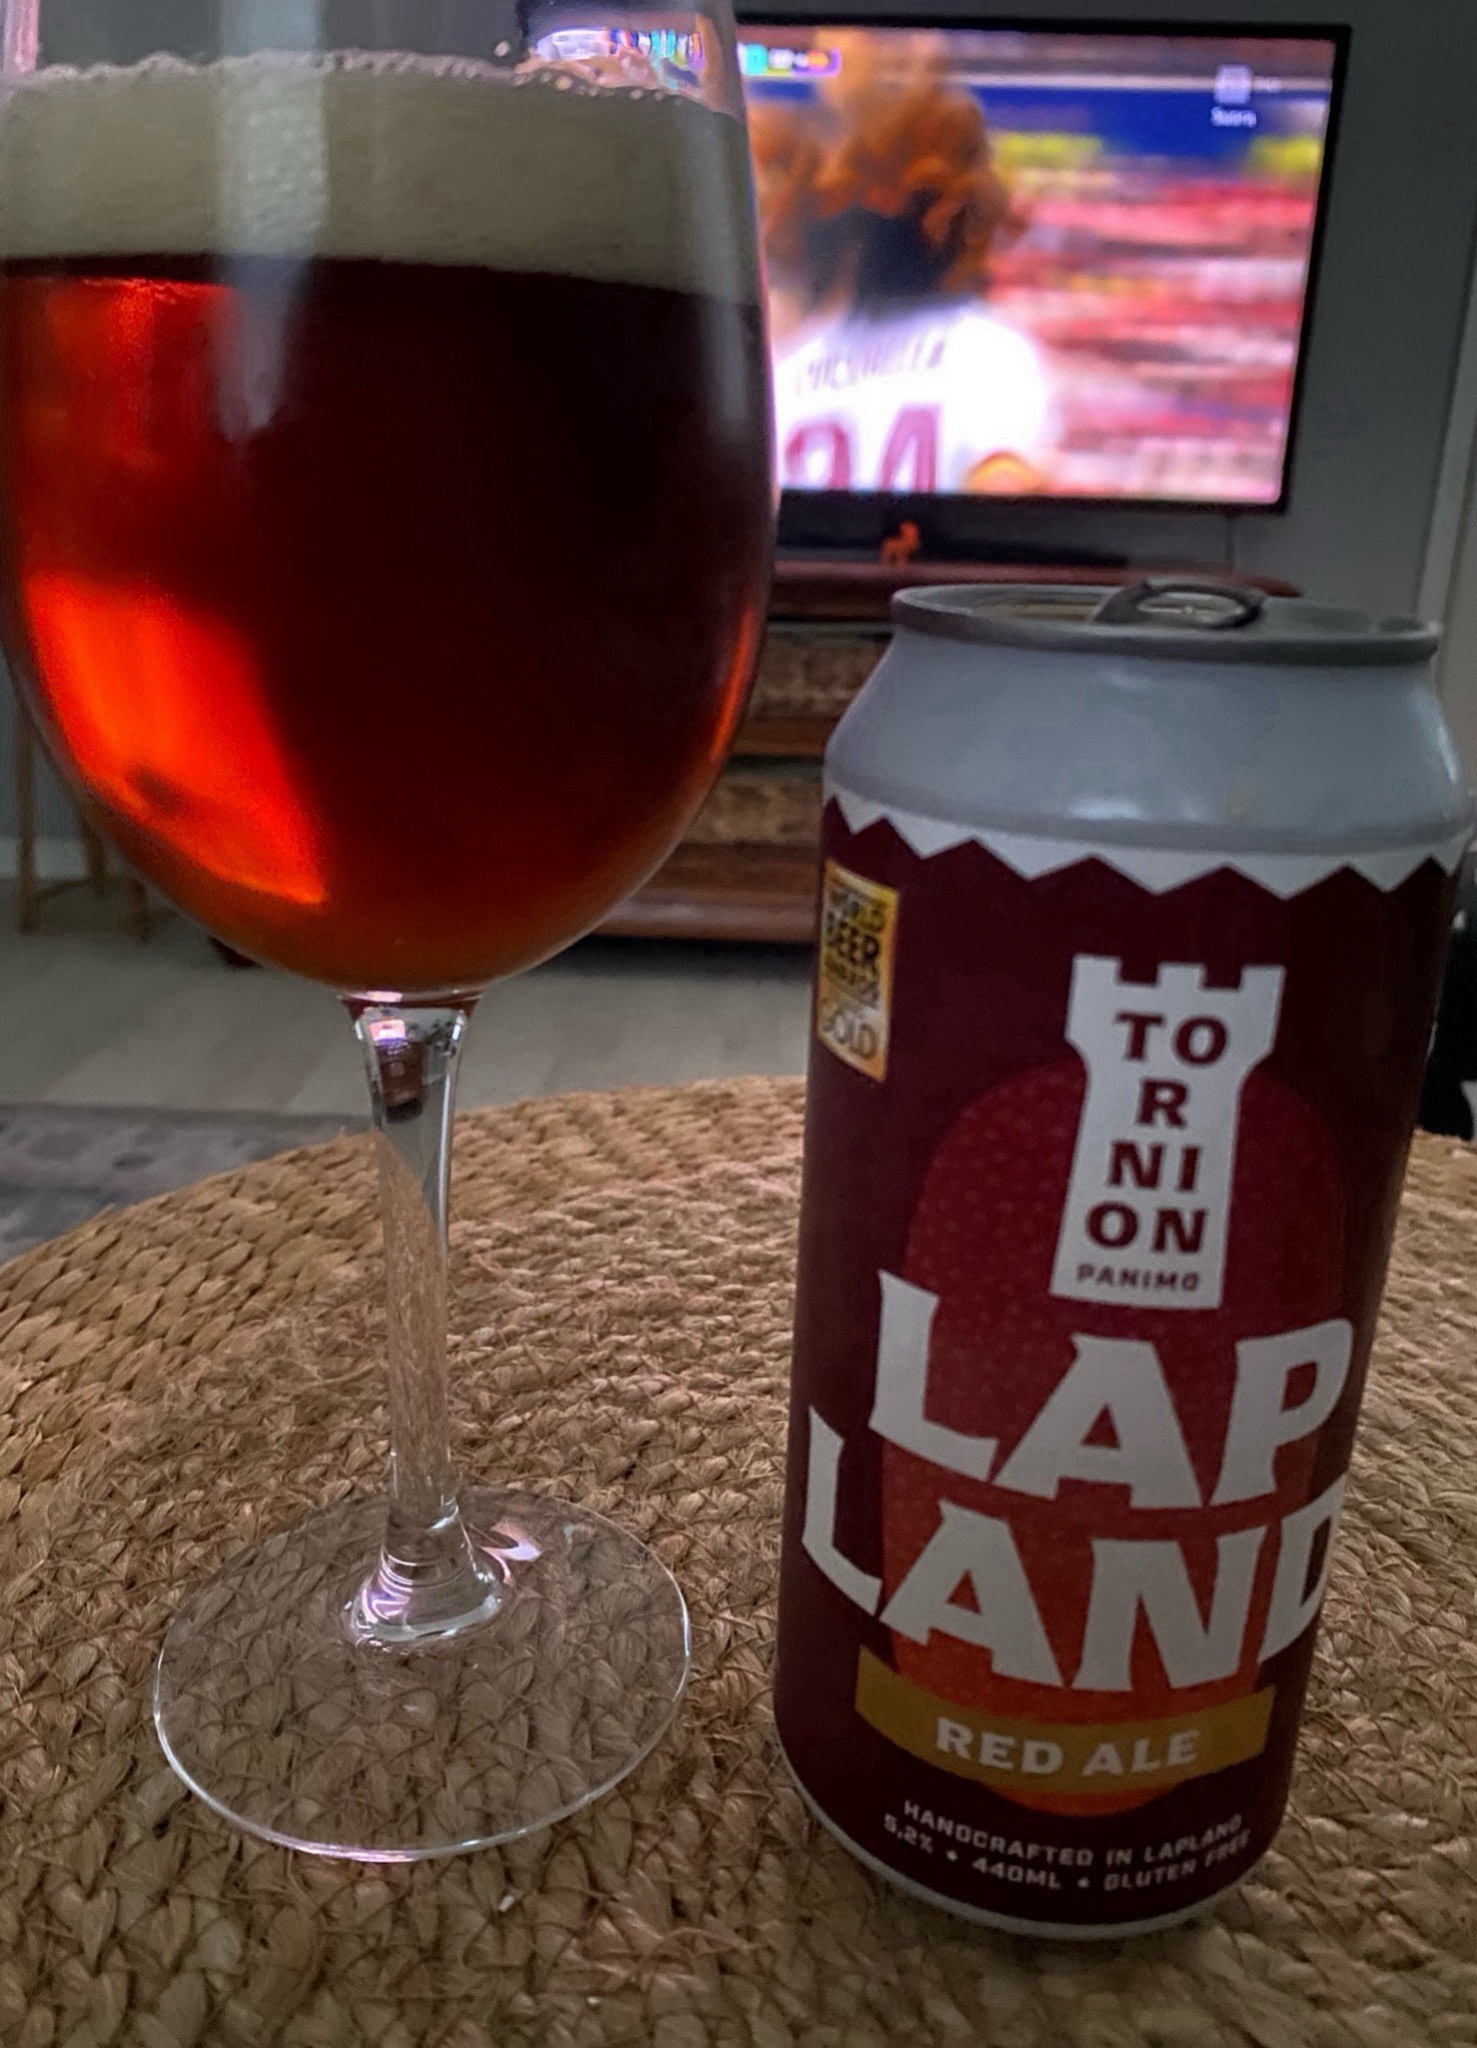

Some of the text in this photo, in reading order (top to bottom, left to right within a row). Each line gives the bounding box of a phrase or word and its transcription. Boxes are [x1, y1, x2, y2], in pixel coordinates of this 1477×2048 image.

[1075, 1263, 1200, 1293] PANIMO
[868, 1269, 1354, 1510] LAP
[935, 1716, 1200, 1777] RED ALE
[903, 1800, 1243, 1867] HANDCRAFTED IN LAPLAND
[971, 1855, 1062, 1890] 440ML
[1103, 1856, 1197, 1892] GLUTEN
[1203, 1828, 1251, 1868] FREE
